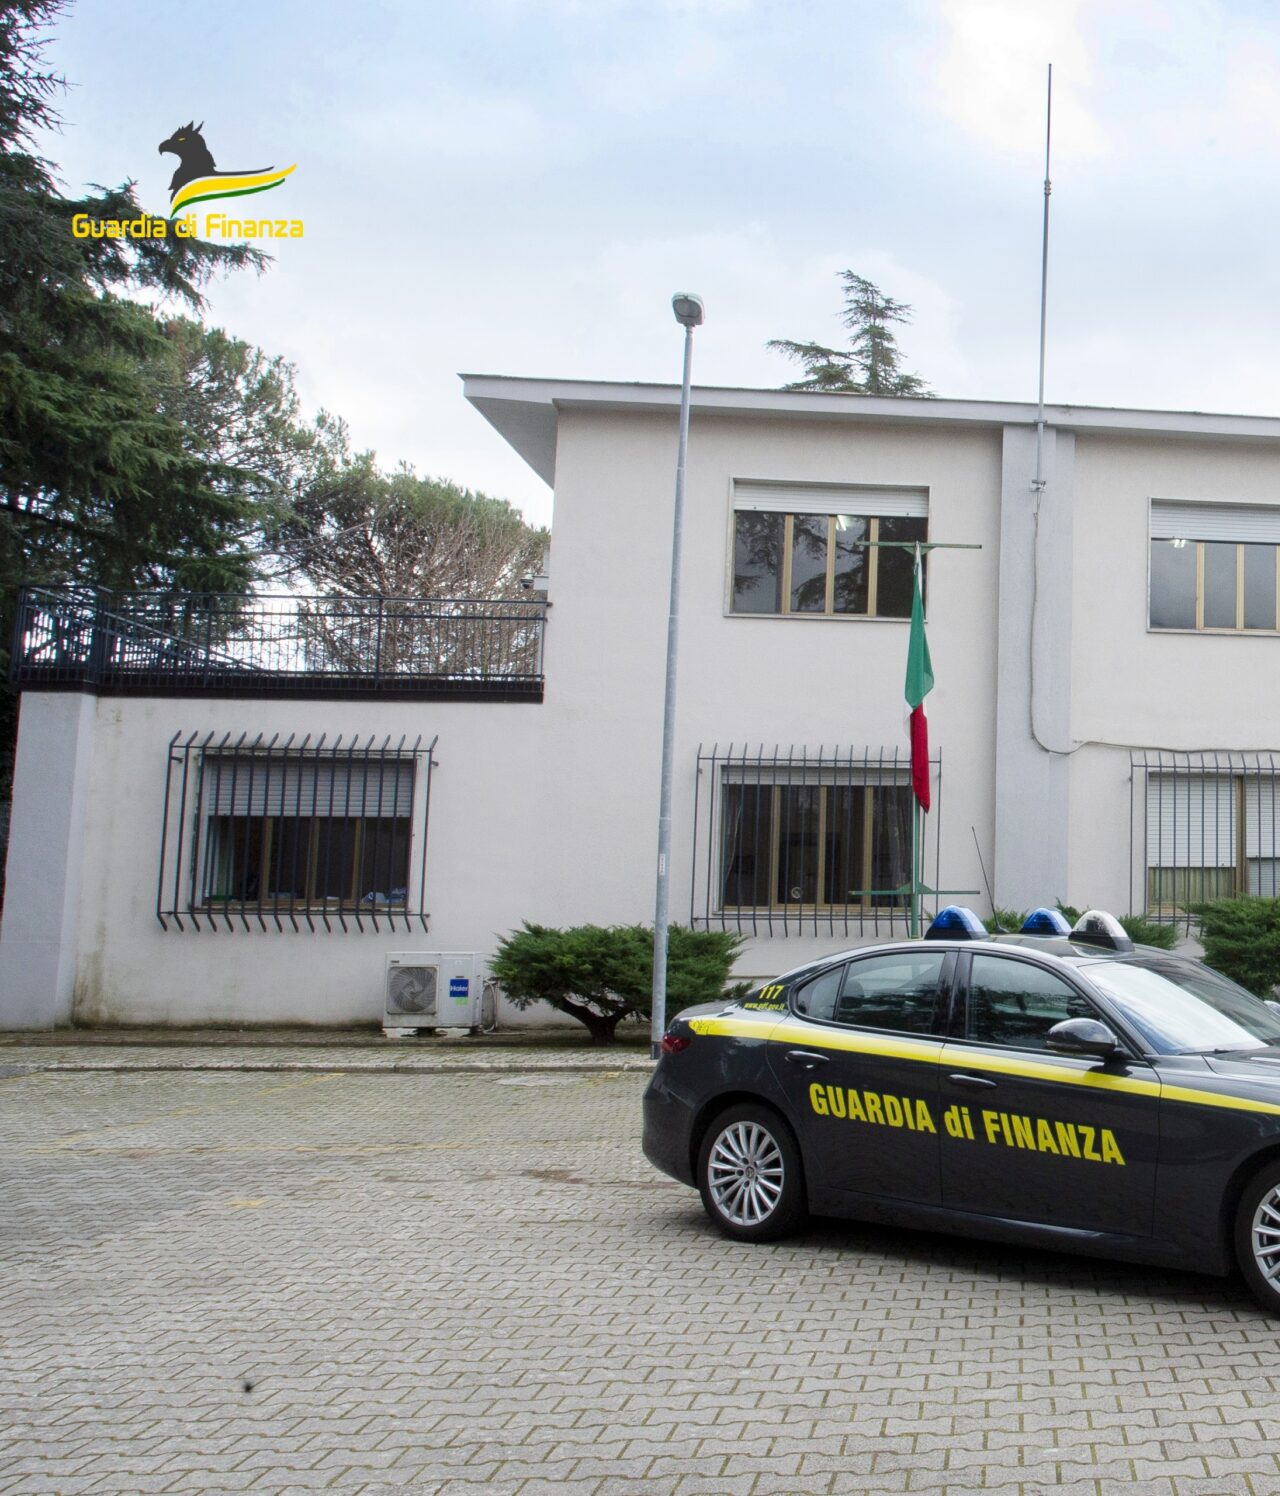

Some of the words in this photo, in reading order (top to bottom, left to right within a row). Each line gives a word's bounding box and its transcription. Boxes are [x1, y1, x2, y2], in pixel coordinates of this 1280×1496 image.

[759, 985, 784, 999] 117
[809, 1082, 937, 1134] GUARDIA
[944, 1105, 975, 1140] di
[982, 1110, 1126, 1166] FINANZA
